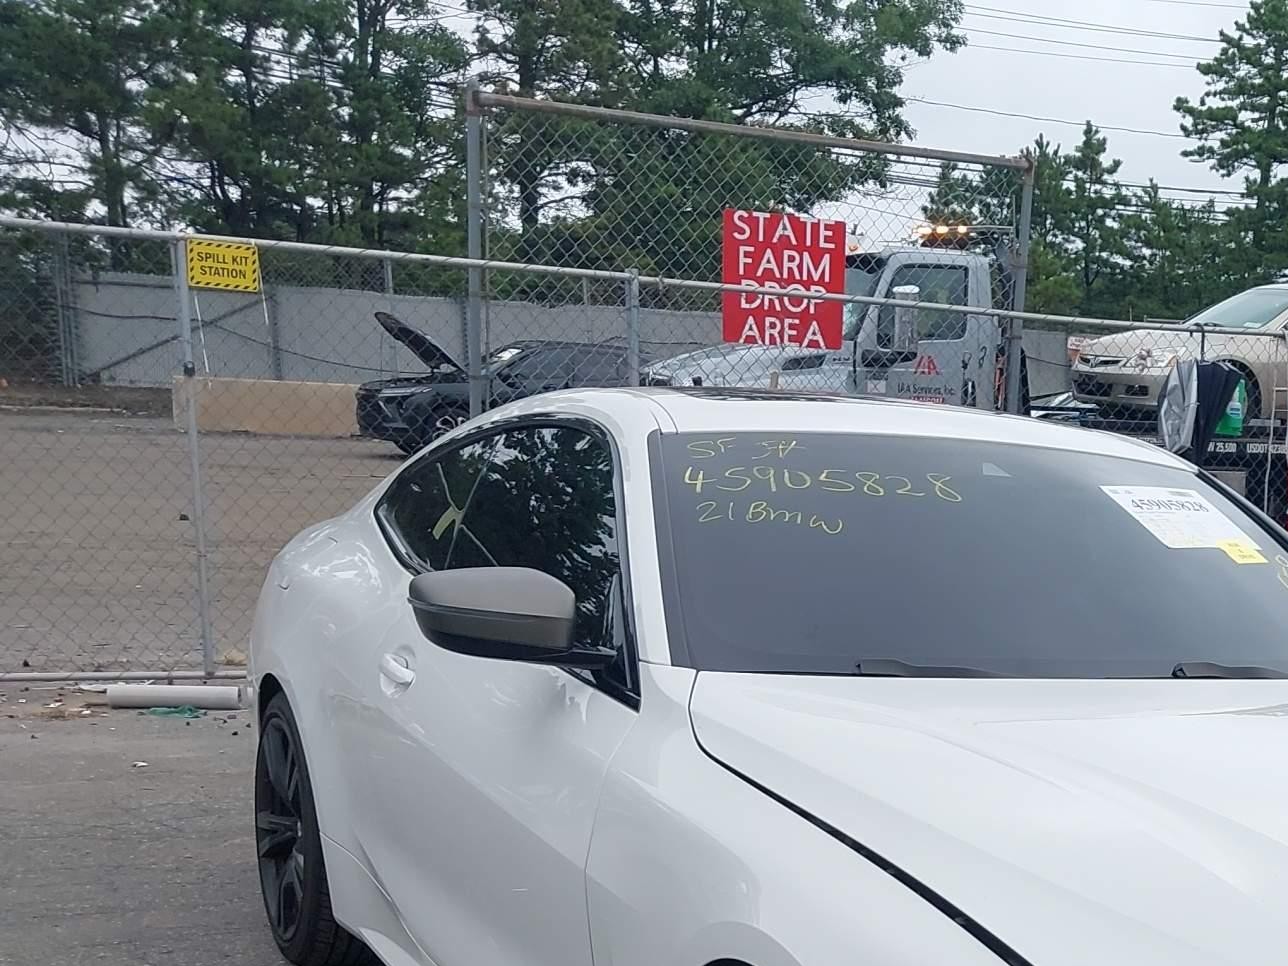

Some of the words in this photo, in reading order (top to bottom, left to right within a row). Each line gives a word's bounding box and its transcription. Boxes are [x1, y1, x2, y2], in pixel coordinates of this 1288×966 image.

[732, 210, 836, 249] STATE
[196, 251, 229, 265] SPILL
[231, 254, 249, 267] KIT
[199, 264, 247, 280] STATION
[738, 245, 831, 283] FARM
[740, 279, 827, 314] DROP
[739, 315, 826, 350] AREA
[683, 465, 963, 502] 45905828
